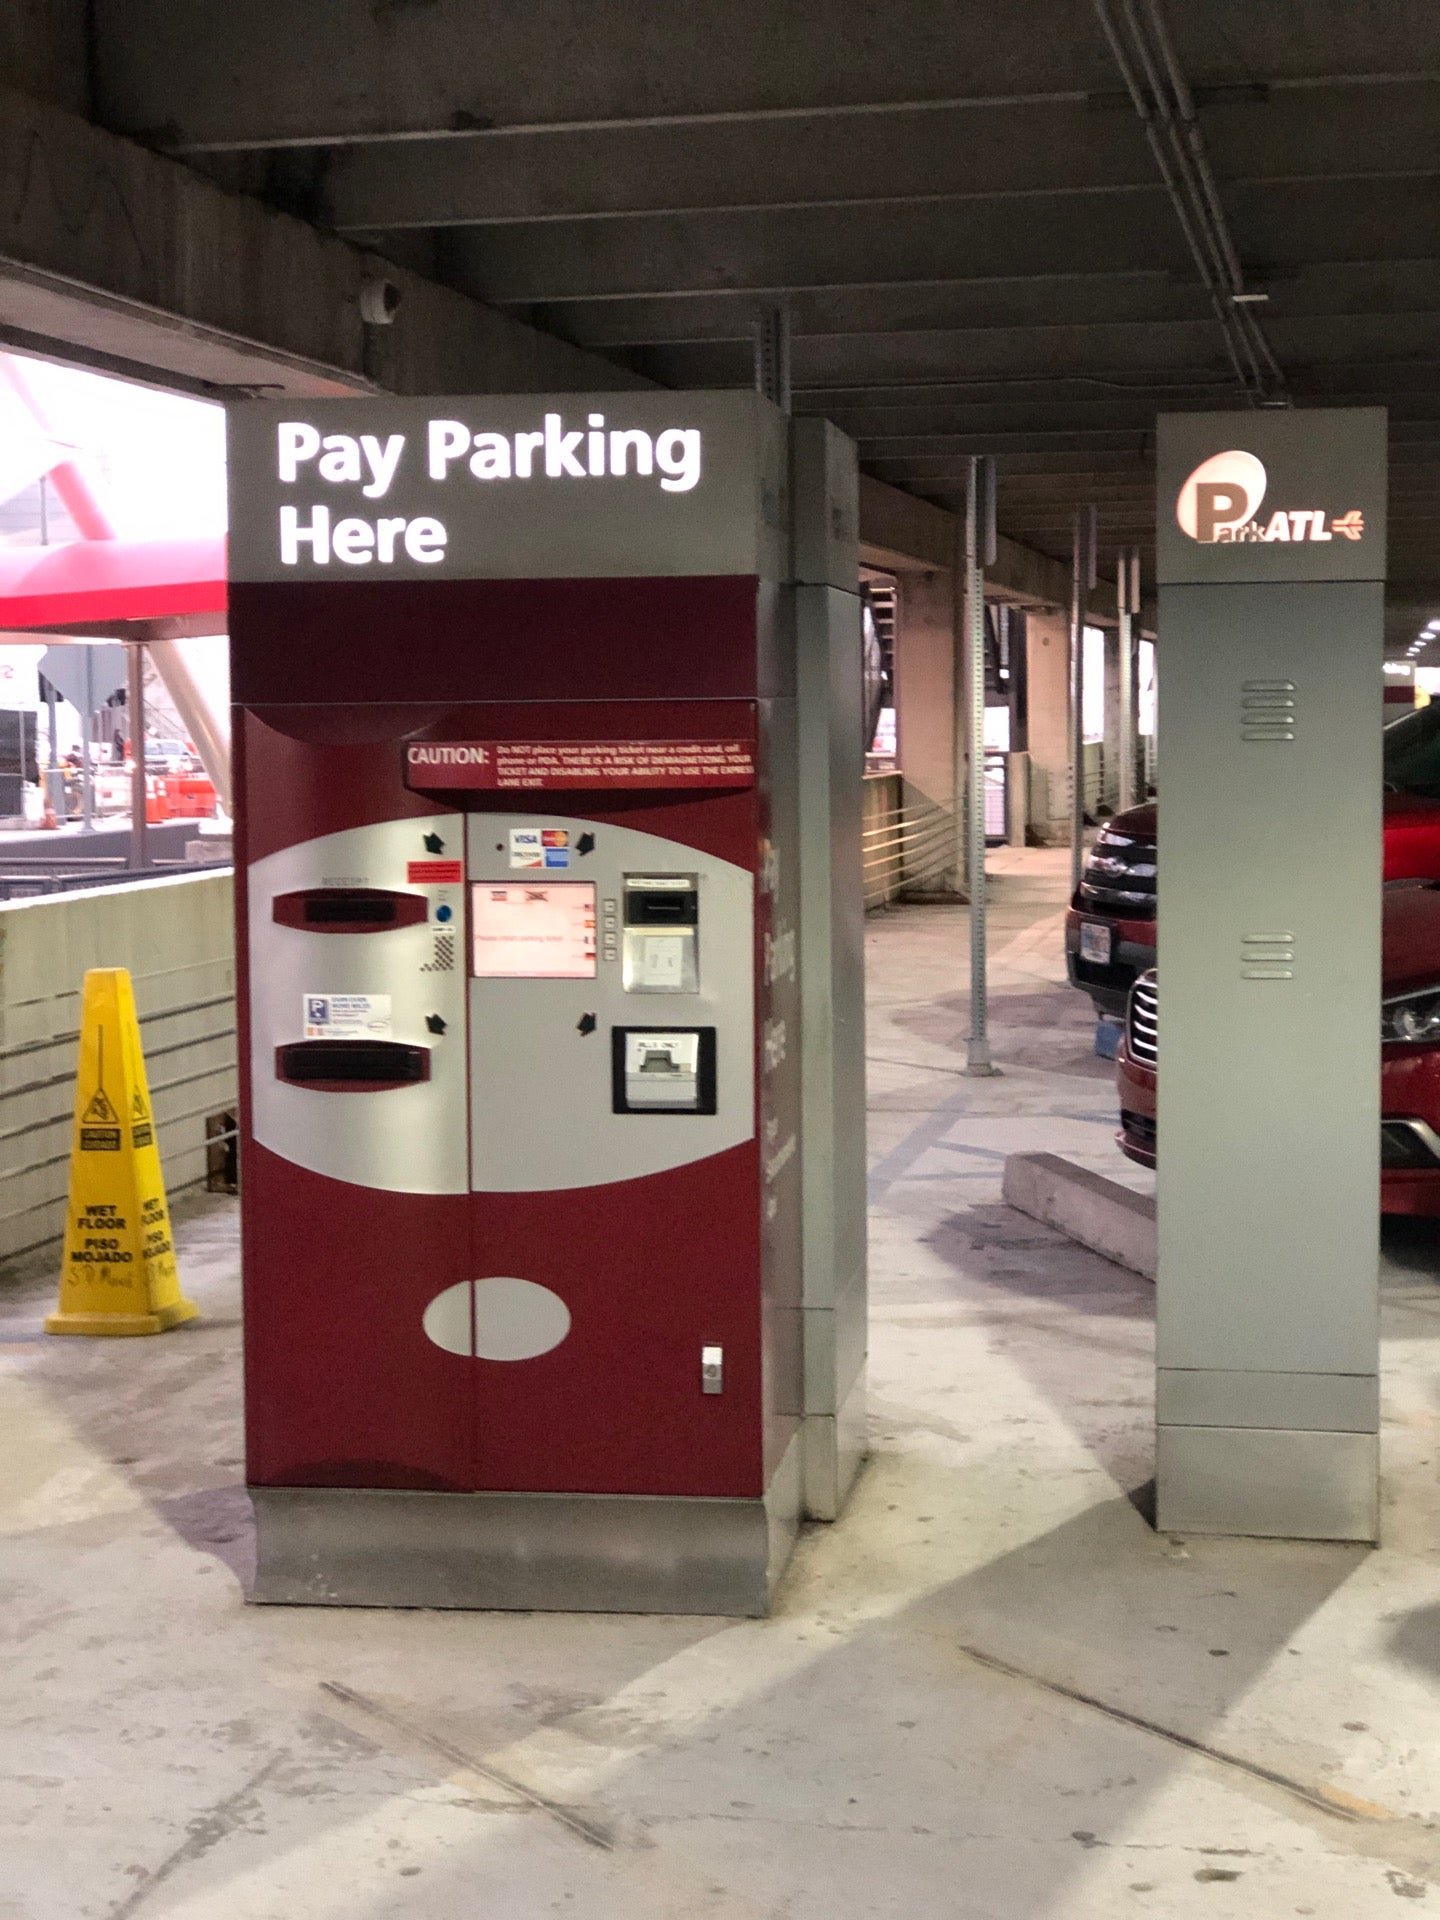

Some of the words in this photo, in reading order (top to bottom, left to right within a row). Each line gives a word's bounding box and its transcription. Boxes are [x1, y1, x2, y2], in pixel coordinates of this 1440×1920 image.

[278, 422, 405, 497] Pay
[428, 413, 701, 492] Parking
[280, 505, 447, 564] Here
[407, 747, 490, 764] CAUTION:
[511, 746, 531, 754] NOT
[558, 747, 580, 756] your
[581, 745, 618, 756] parking
[618, 745, 645, 754] ticket
[562, 757, 592, 765] THERE
[593, 757, 603, 765] IS
[613, 756, 635, 764] RISK
[636, 756, 650, 764] OF
[651, 755, 726, 764] DEMAGNETIZING
[727, 754, 752, 763] YOUR
[498, 767, 527, 776] TICKET
[528, 767, 550, 775] AND
[550, 767, 601, 776] DISABLING
[602, 767, 630, 775] YOUR
[631, 766, 666, 775] ABILITY
[668, 766, 682, 774] TO
[682, 766, 701, 775] USE
[702, 766, 720, 774] THE
[497, 778, 521, 786] LANE
[85, 1205, 117, 1217] WET
[78, 1218, 127, 1230] FLOOR
[85, 1238, 119, 1250] PISO
[71, 1251, 133, 1263] MOJADO
